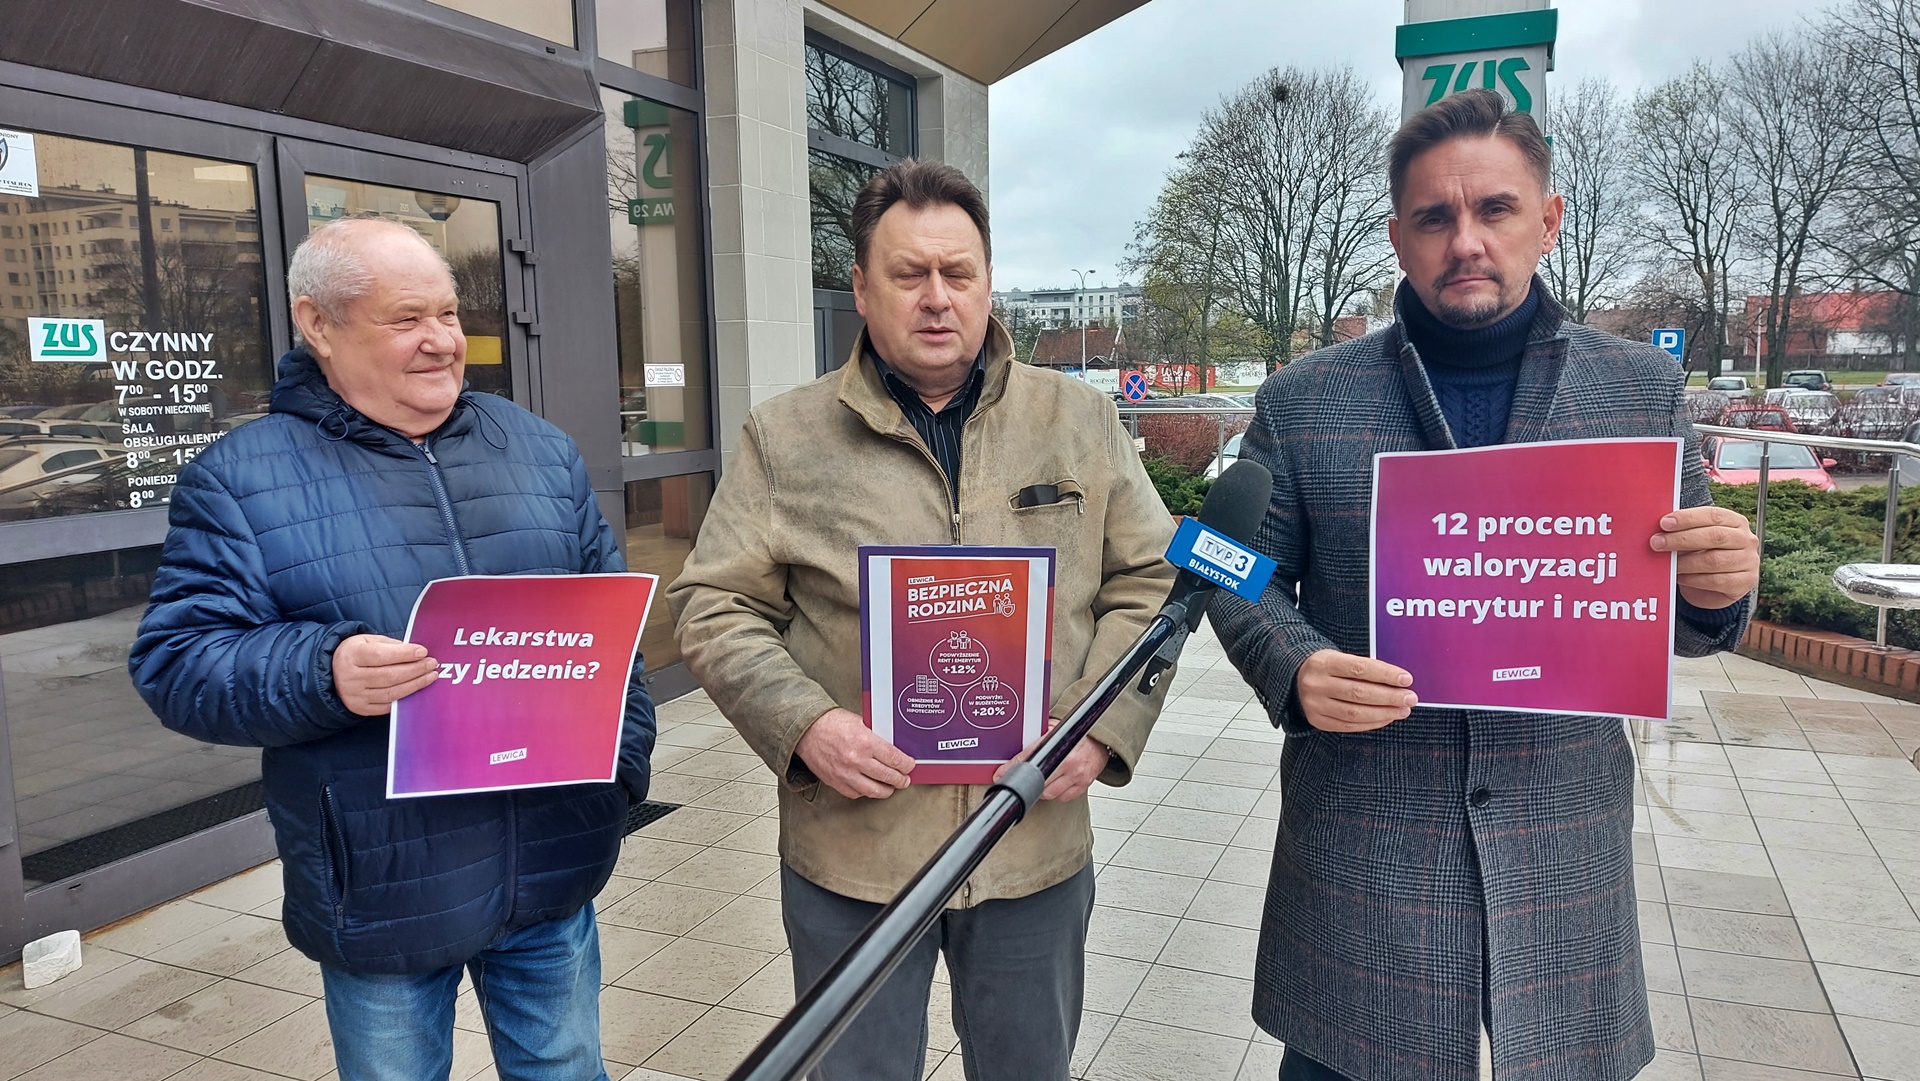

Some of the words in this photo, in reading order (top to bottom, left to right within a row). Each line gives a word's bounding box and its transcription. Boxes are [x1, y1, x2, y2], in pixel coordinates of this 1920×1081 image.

[40, 323, 98, 356] ZUS
[110, 332, 214, 352] CZYNNY
[1659, 332, 1678, 349] P
[111, 360, 137, 381] W
[145, 360, 223, 380] GODZ.
[118, 407, 127, 417] W
[128, 405, 163, 417] SOBOTY
[164, 403, 210, 415] NIECZYNNE
[122, 423, 154, 434] SALA
[123, 435, 176, 448] OBSŁUGI
[179, 430, 229, 444] KLIENTÓ
[128, 474, 177, 487] PONIEDZI
[1431, 512, 1468, 536] 12
[1478, 513, 1612, 542] procent
[1188, 558, 1241, 590] BIAŁYSTOK
[1423, 552, 1618, 584] waloryzacji
[908, 578, 1013, 601] BEZPIECZNA
[908, 597, 987, 618] RODZINA
[1386, 596, 1544, 624] emerytur
[1553, 594, 1562, 618] i
[1573, 597, 1658, 621] rent!
[453, 627, 594, 647] Lekarstwa
[473, 658, 600, 684] jedzenie?
[942, 664, 976, 674] +12%
[1496, 668, 1538, 680] LEWICA
[972, 706, 1006, 716] +20%
[940, 740, 977, 749] LEWICA
[492, 750, 525, 763] LEWICA
